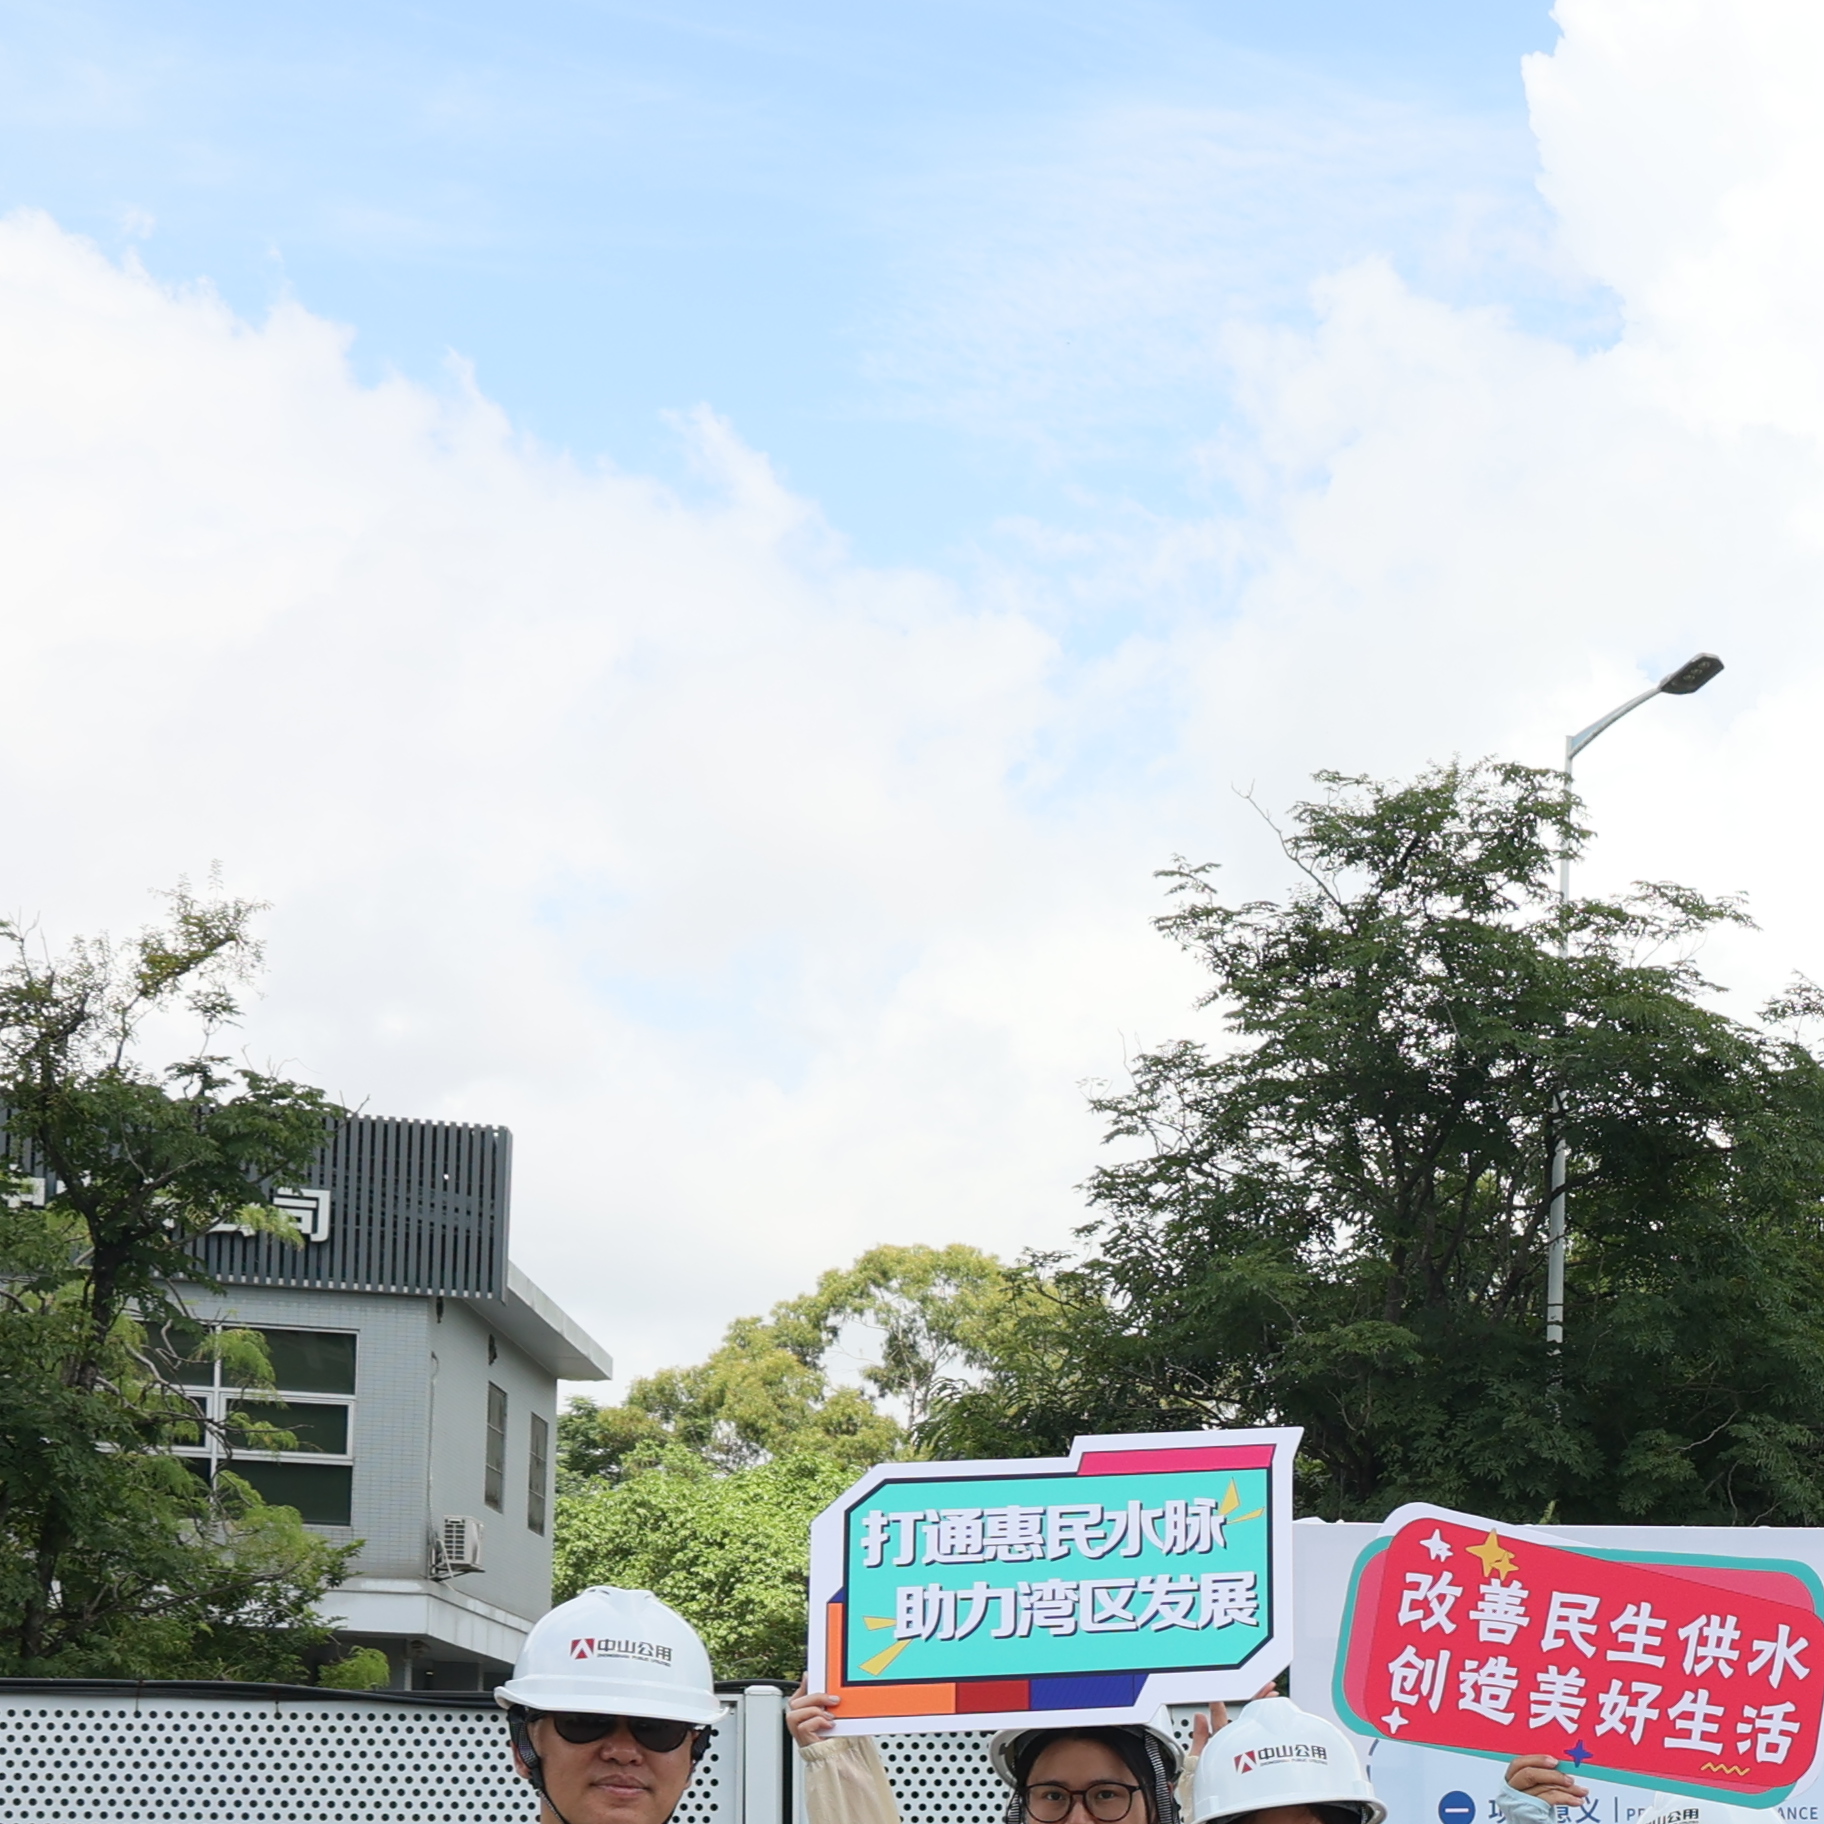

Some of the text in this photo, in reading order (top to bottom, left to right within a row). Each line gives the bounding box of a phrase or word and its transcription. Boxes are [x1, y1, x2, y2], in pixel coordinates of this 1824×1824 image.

[860, 1497, 1226, 1570] 打通惠民水脉
[894, 1570, 1259, 1642] 助力湾区发展
[1397, 1571, 1812, 1690] 改善民生供水
[597, 1638, 673, 1662] 中山公用
[1387, 1644, 1802, 1765] 创造美好生活
[1258, 1744, 1328, 1761] 中山公用
